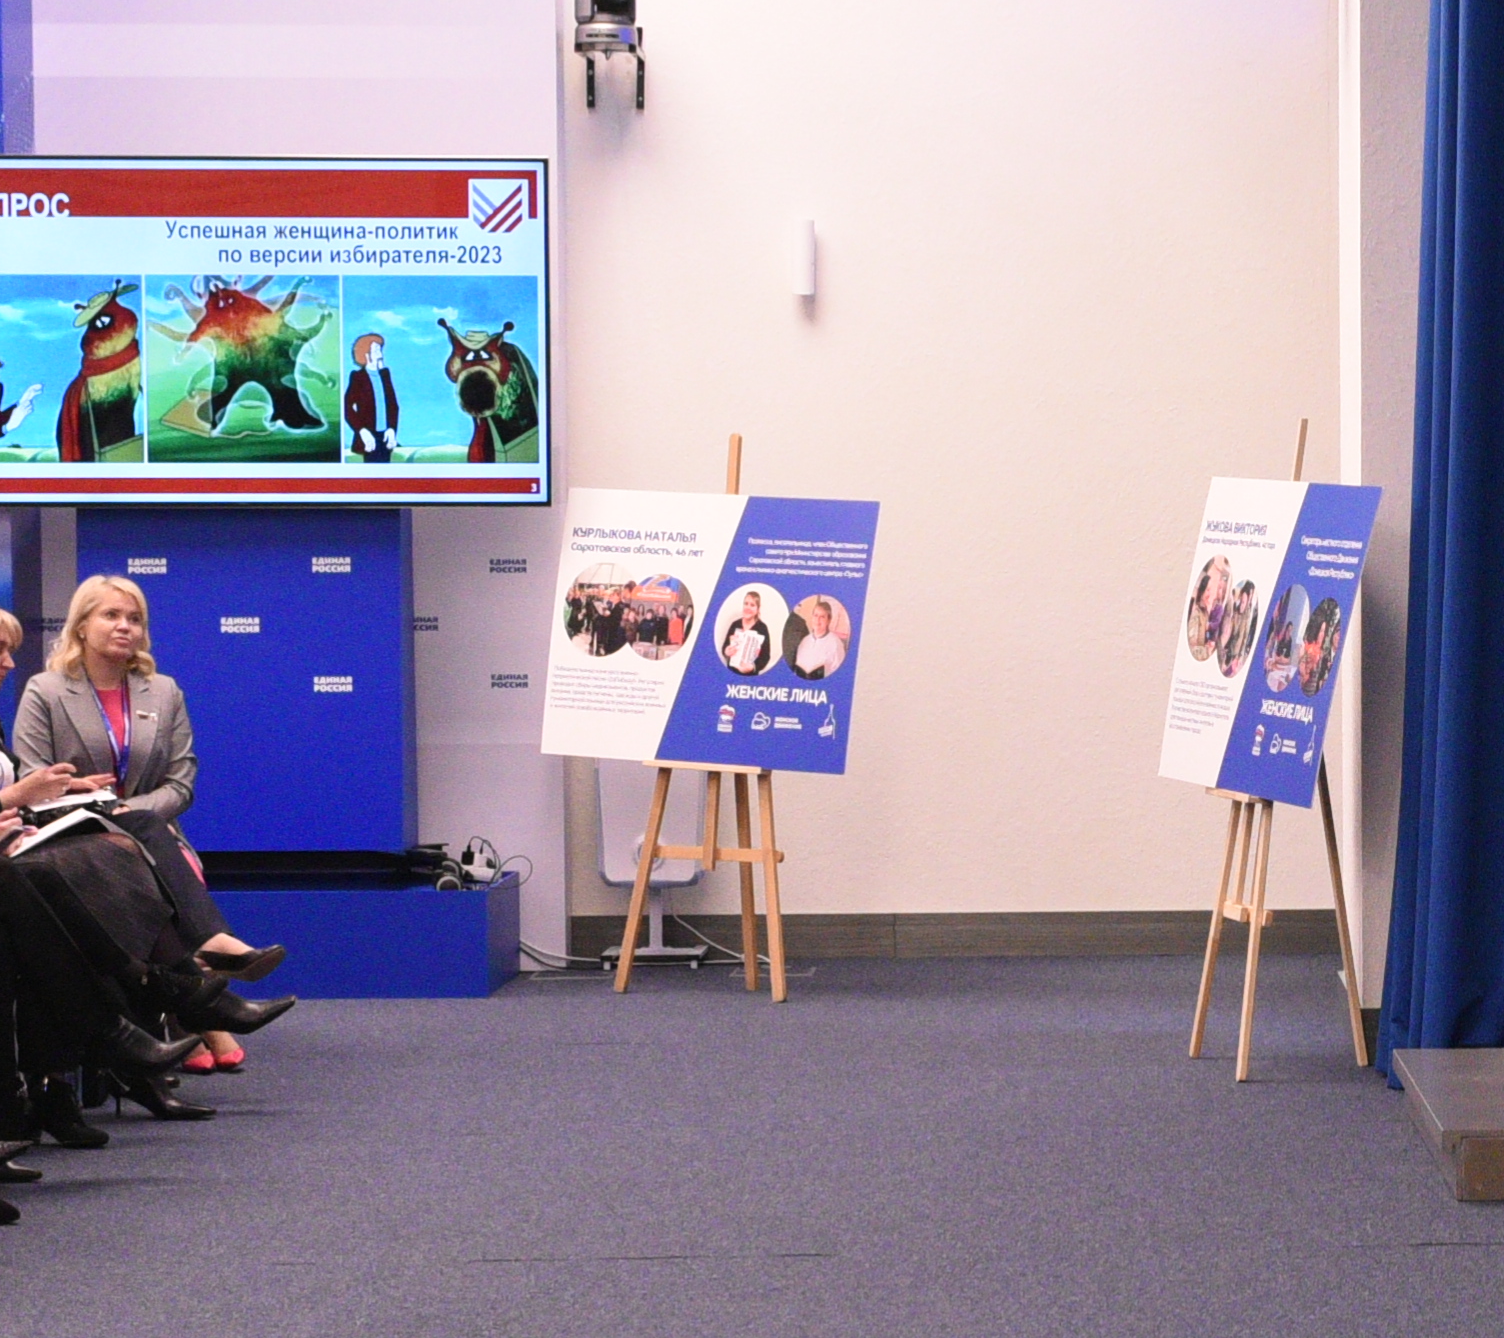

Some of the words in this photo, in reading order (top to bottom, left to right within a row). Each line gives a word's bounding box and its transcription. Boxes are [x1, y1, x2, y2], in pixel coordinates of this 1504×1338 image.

[165, 220, 268, 240] Успешная
[274, 223, 459, 241] женщина-политик
[218, 249, 243, 263] по
[249, 249, 322, 266] версии
[330, 244, 502, 266] избирателя-2023
[530, 484, 537, 492] 3
[572, 527, 642, 541] КУРЛЫКОВА
[644, 530, 697, 543] НАТАЛЬЯ
[570, 542, 631, 553] Саратовская
[128, 558, 167, 566] ЕДИНАЯ
[312, 557, 351, 565] ЕДИНАЯ
[489, 558, 527, 566] ЕДИНАЯ
[128, 566, 167, 574] РОССИЯ
[312, 565, 351, 573] РОССИЯ
[489, 566, 527, 574] РОССИЯ
[220, 617, 260, 625] ЕДИНАЯ
[220, 625, 260, 634] РОССИЯ
[313, 676, 353, 684] ЕДИНАЯ
[491, 673, 529, 681] ЕДИНАЯ
[313, 684, 353, 693] РОССИЯ
[491, 681, 529, 689] РОССИЯ
[725, 684, 789, 701] ЖЕНСКИЕ
[790, 688, 828, 706] ЛИЦА
